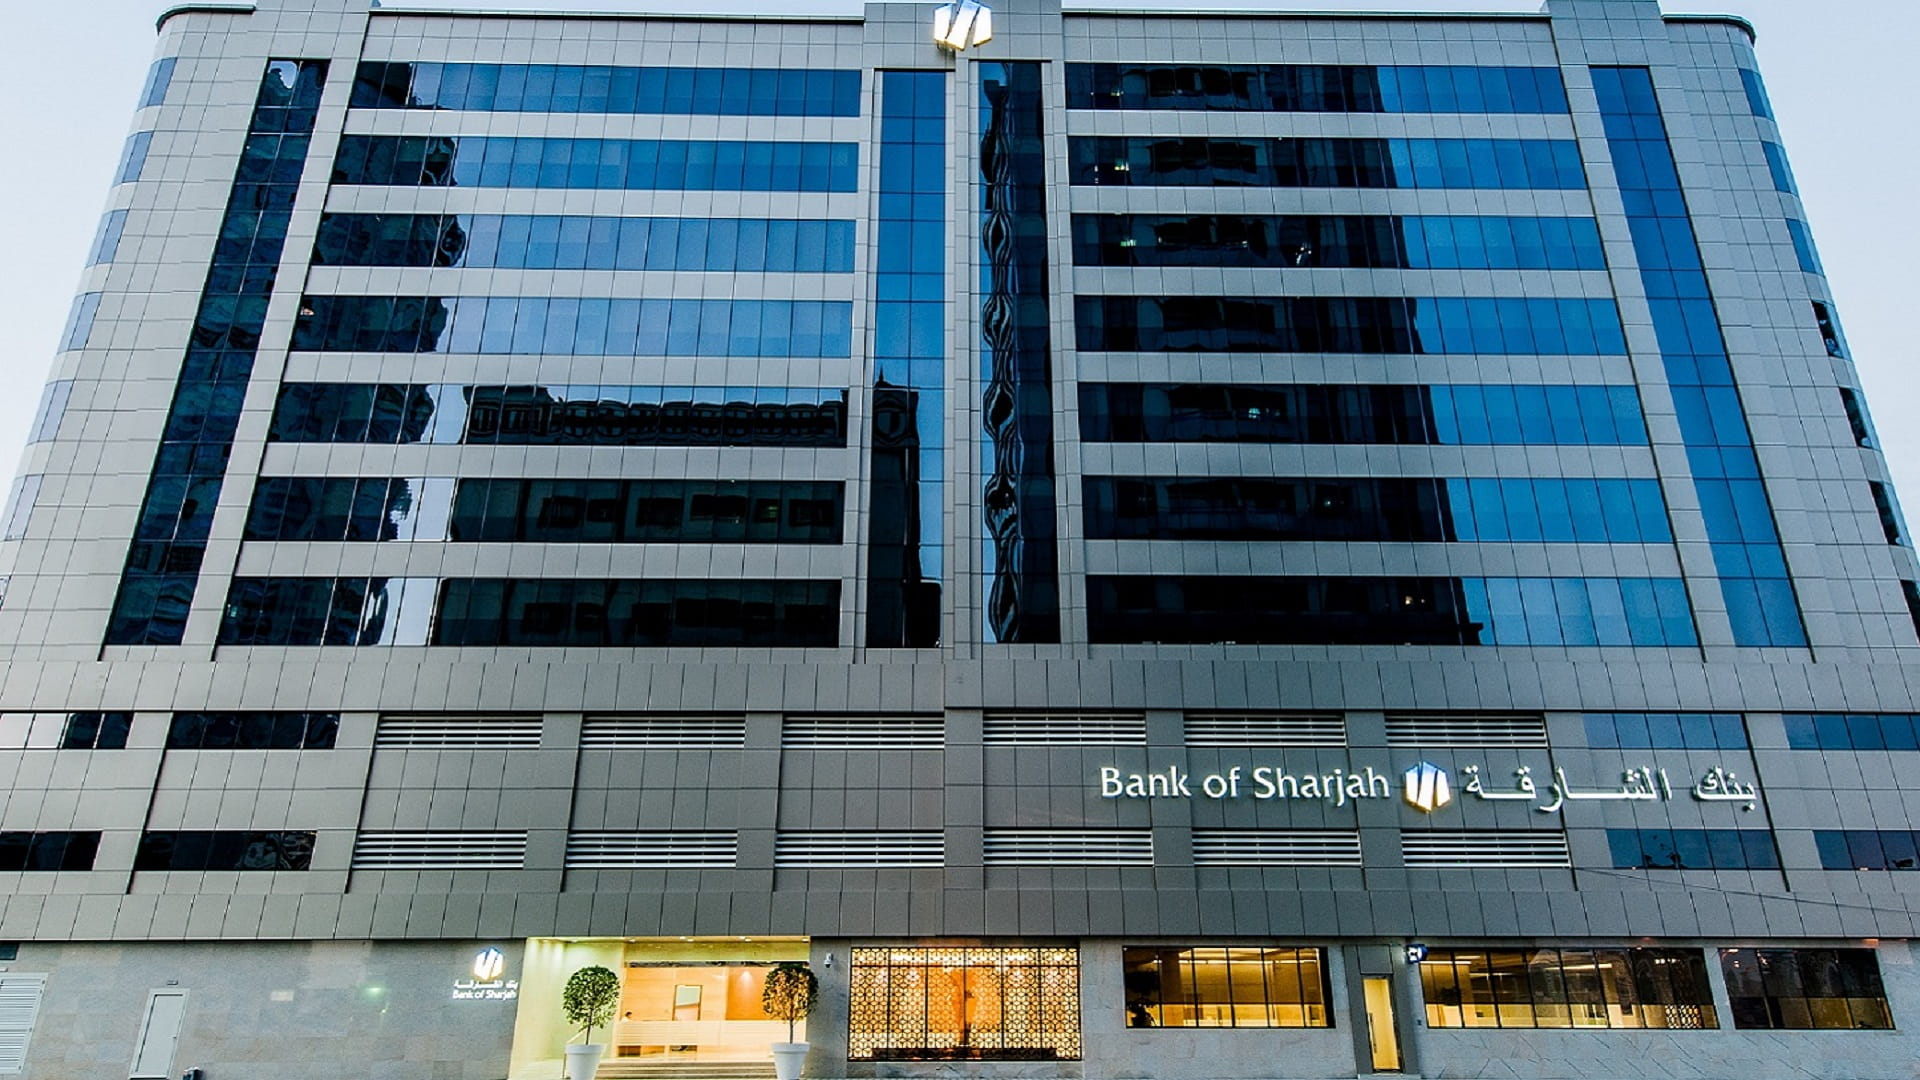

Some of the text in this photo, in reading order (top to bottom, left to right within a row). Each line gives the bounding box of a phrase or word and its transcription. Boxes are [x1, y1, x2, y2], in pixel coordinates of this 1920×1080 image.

[1101, 766, 1390, 807] Bank of Sharjah
[1464, 765, 1757, 812] بنك الشارقة
[453, 989, 517, 1000] Bank of Sharjah
